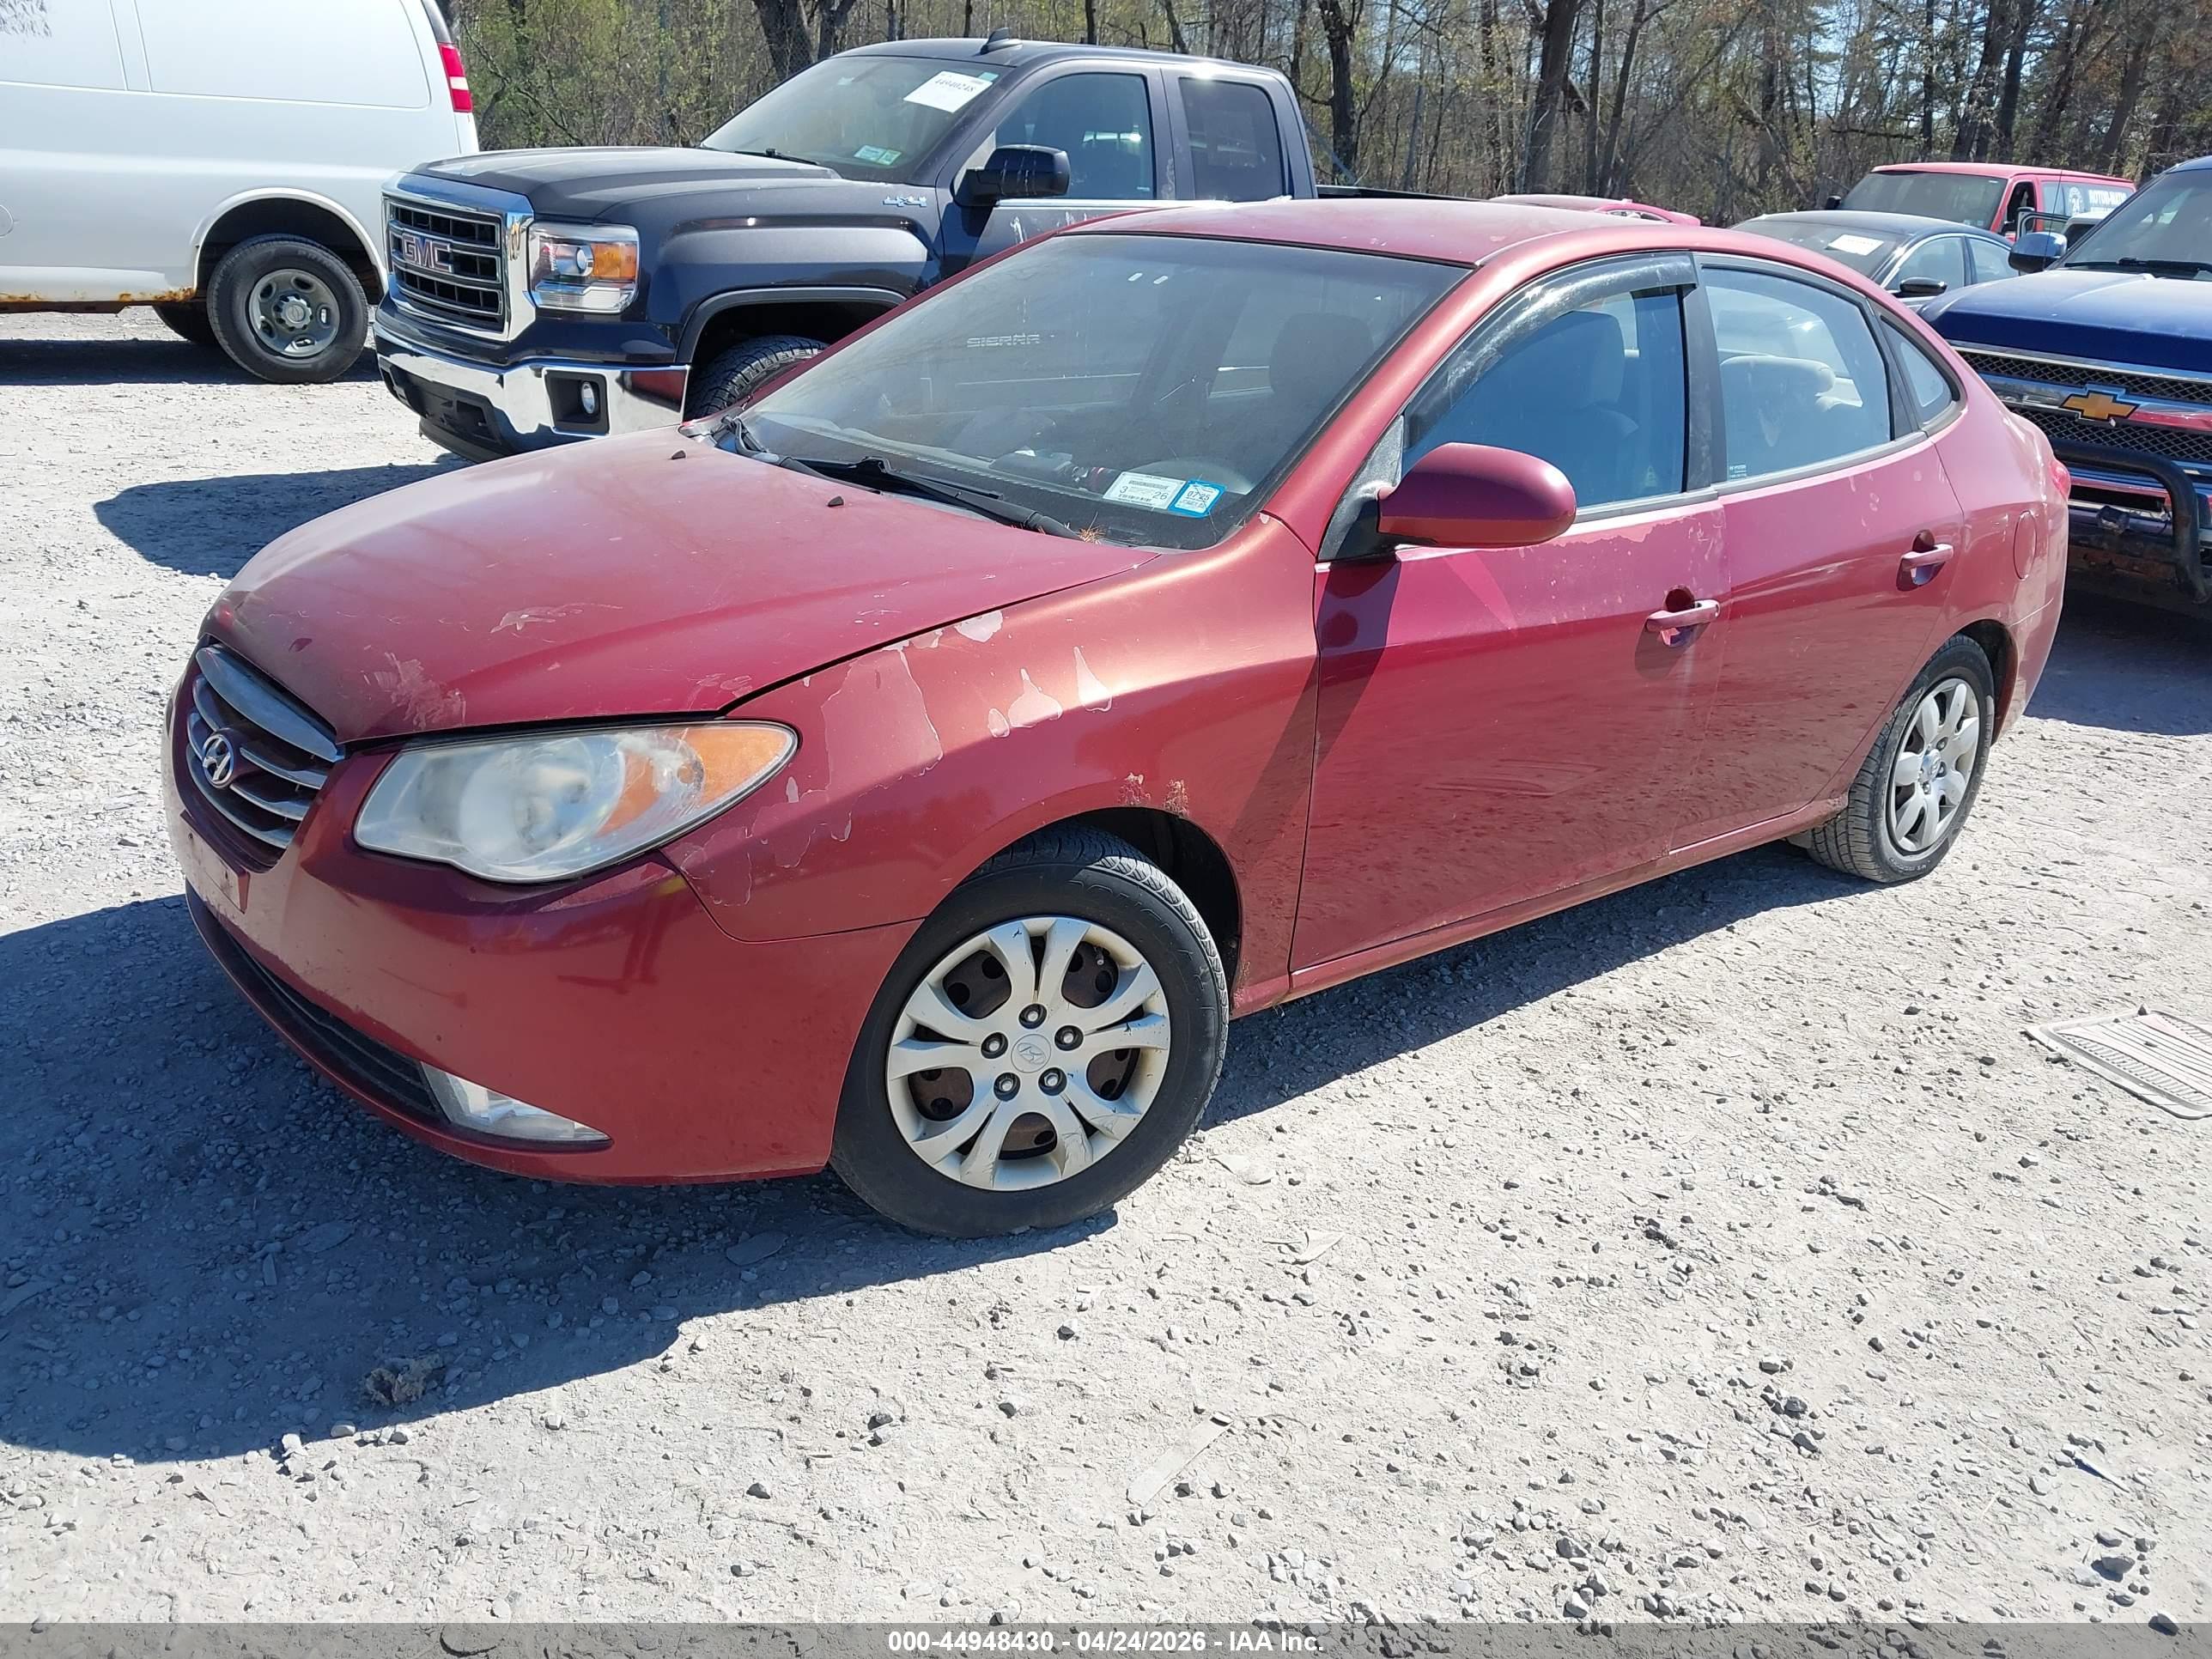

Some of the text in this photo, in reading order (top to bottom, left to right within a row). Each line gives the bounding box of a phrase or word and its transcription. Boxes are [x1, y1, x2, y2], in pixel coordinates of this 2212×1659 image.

[403, 233, 453, 272] GMC
[967, 332, 1040, 348] SIERRA
[1119, 485, 1128, 494] 3
[1152, 491, 1169, 500] 26
